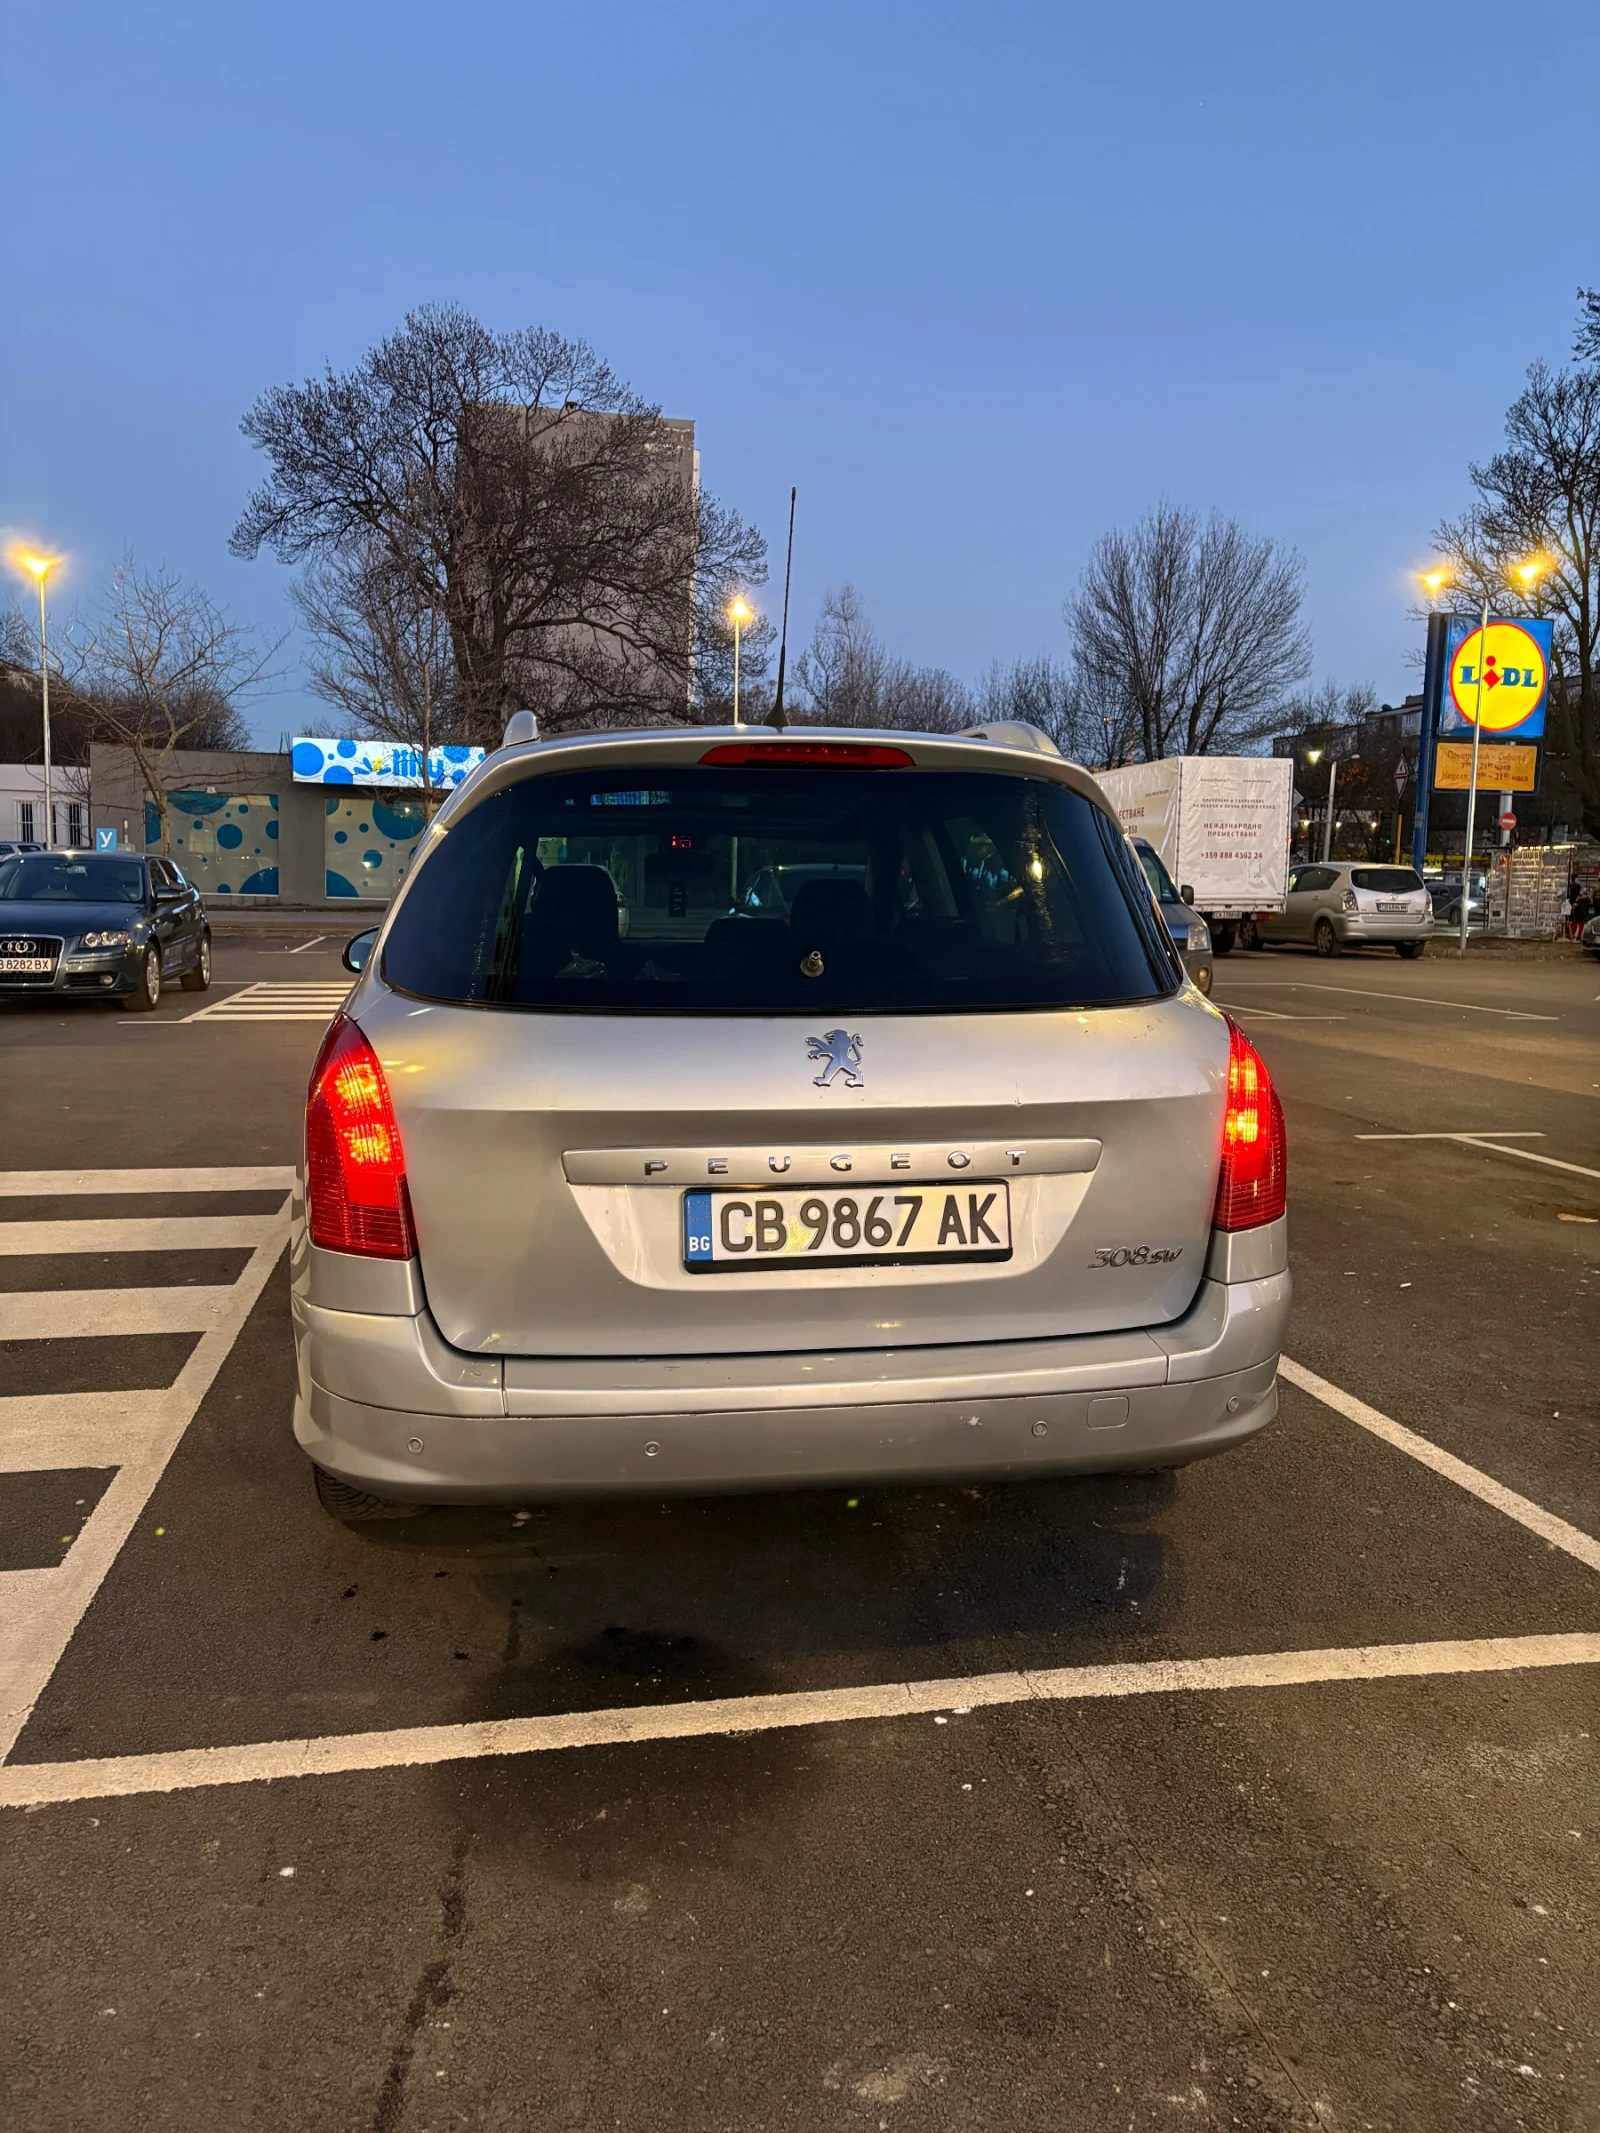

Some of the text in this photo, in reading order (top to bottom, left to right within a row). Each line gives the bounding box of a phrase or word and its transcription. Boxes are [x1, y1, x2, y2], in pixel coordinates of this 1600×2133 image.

[1117, 806, 1145, 820] ЕСТВАНЕ
[1203, 822, 1263, 830] МЕЖДУНАРОДНО
[1200, 851, 1218, 859] +359
[6, 959, 33, 970] 8282
[35, 959, 49, 970] BX
[644, 1149, 1027, 1176] PEUGEOT
[720, 1193, 1001, 1252] CB 9867 AK
[689, 1236, 710, 1252] BG
